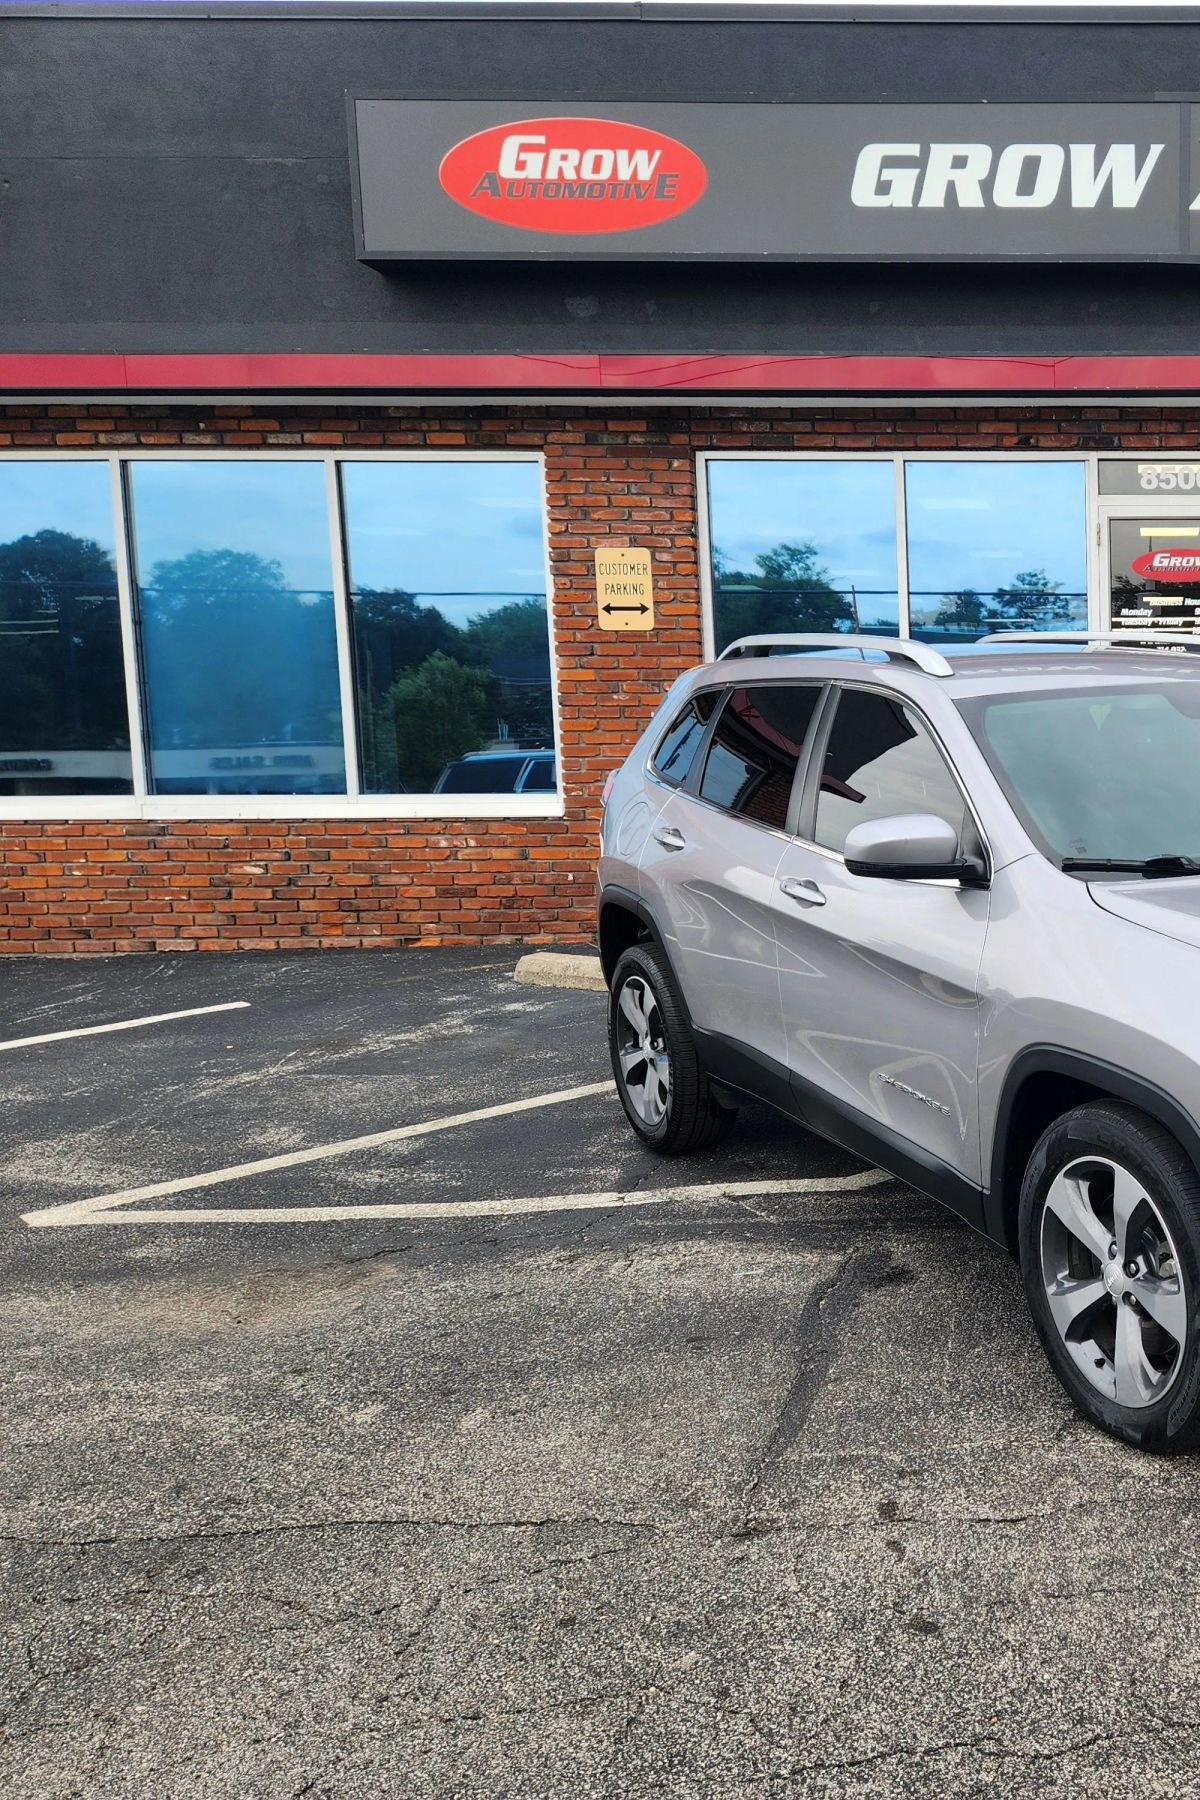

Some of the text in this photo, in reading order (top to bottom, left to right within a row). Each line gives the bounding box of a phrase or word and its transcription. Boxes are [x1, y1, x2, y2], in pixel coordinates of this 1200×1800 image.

[851, 143, 1165, 210] GROW
[470, 170, 680, 199] AUTOMOTIVE
[599, 563, 648, 576] CUSTOMER
[604, 583, 645, 595] PARKING
[1120, 607, 1152, 617] Monday
